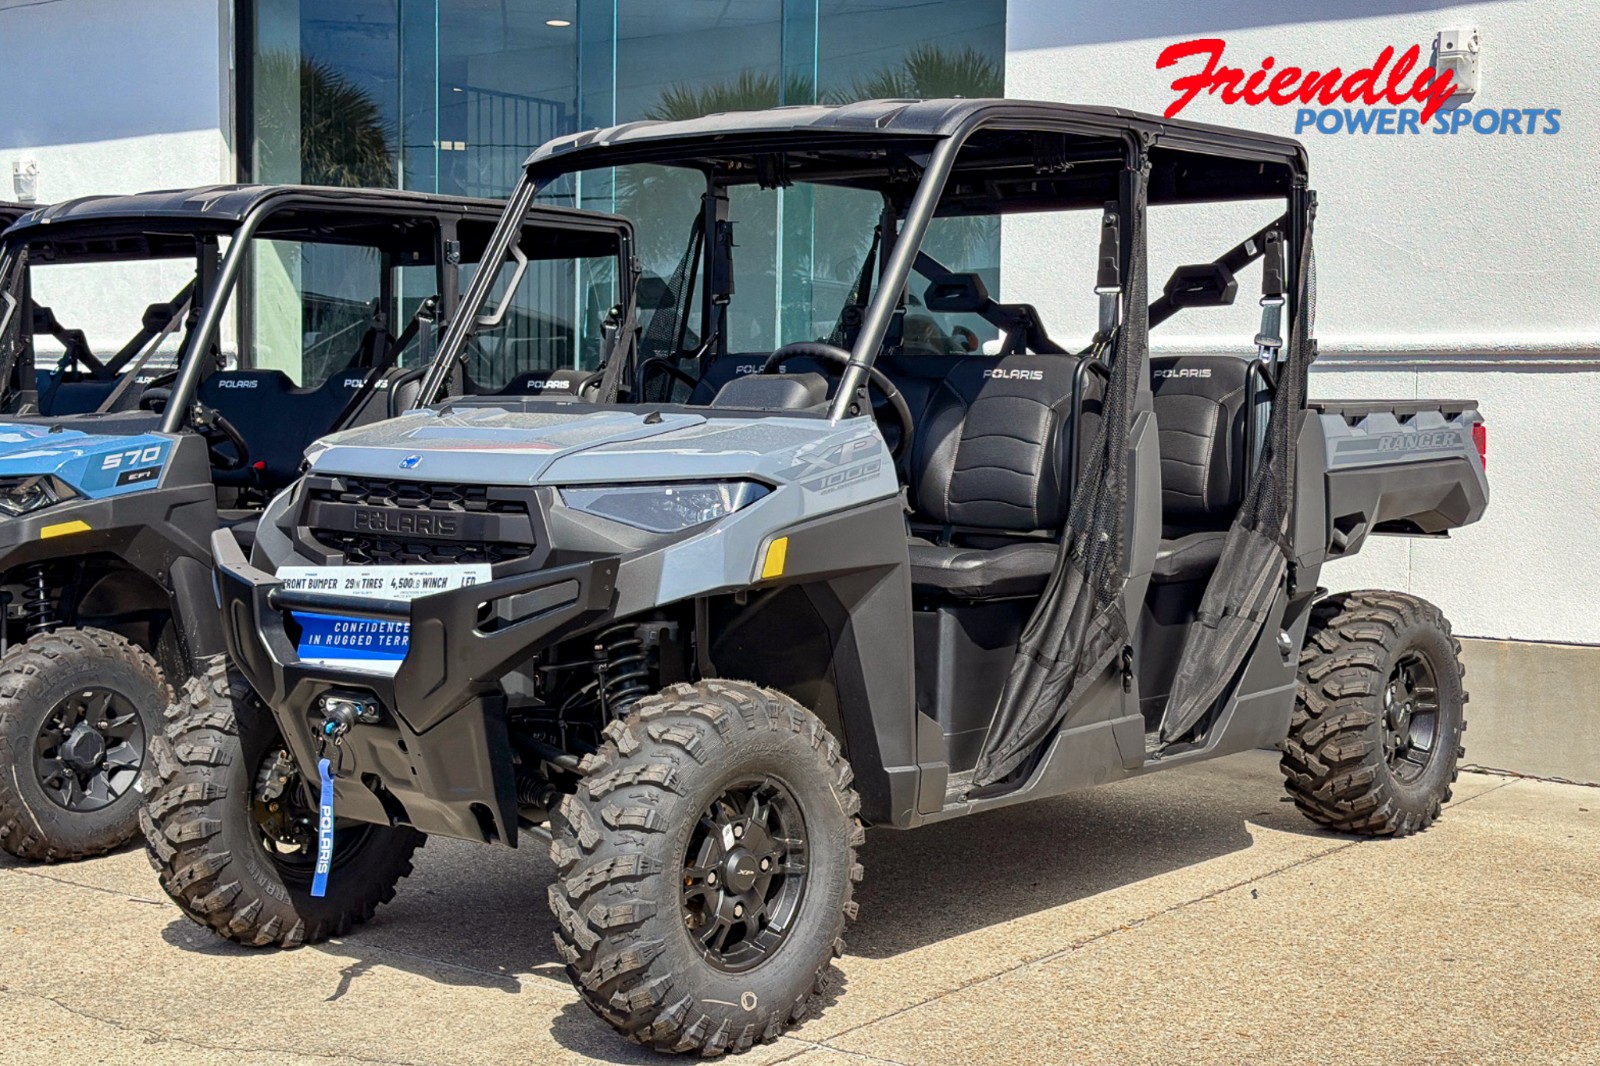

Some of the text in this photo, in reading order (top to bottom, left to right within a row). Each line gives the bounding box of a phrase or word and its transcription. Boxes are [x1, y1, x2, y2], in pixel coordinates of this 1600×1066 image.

[736, 365, 786, 374] POLAS
[983, 368, 1043, 380] POLARIS
[1153, 368, 1211, 379] POLARIS
[218, 380, 258, 388] POLARIS
[343, 379, 388, 388] POLIS
[527, 380, 570, 389] POLARIS
[1377, 431, 1457, 451] RANGER
[101, 447, 161, 470] 570
[794, 434, 881, 480] XP
[128, 471, 151, 480] EFI
[819, 459, 881, 489] 1000
[353, 509, 457, 536] POLARIS
[308, 578, 338, 589] BUMPER
[362, 578, 384, 589] TIRES
[422, 577, 448, 589] WINCH
[334, 622, 410, 633] CONFIDENCE
[308, 634, 409, 646] IN RUGGED TERR
[317, 805, 331, 874] POLARIS
